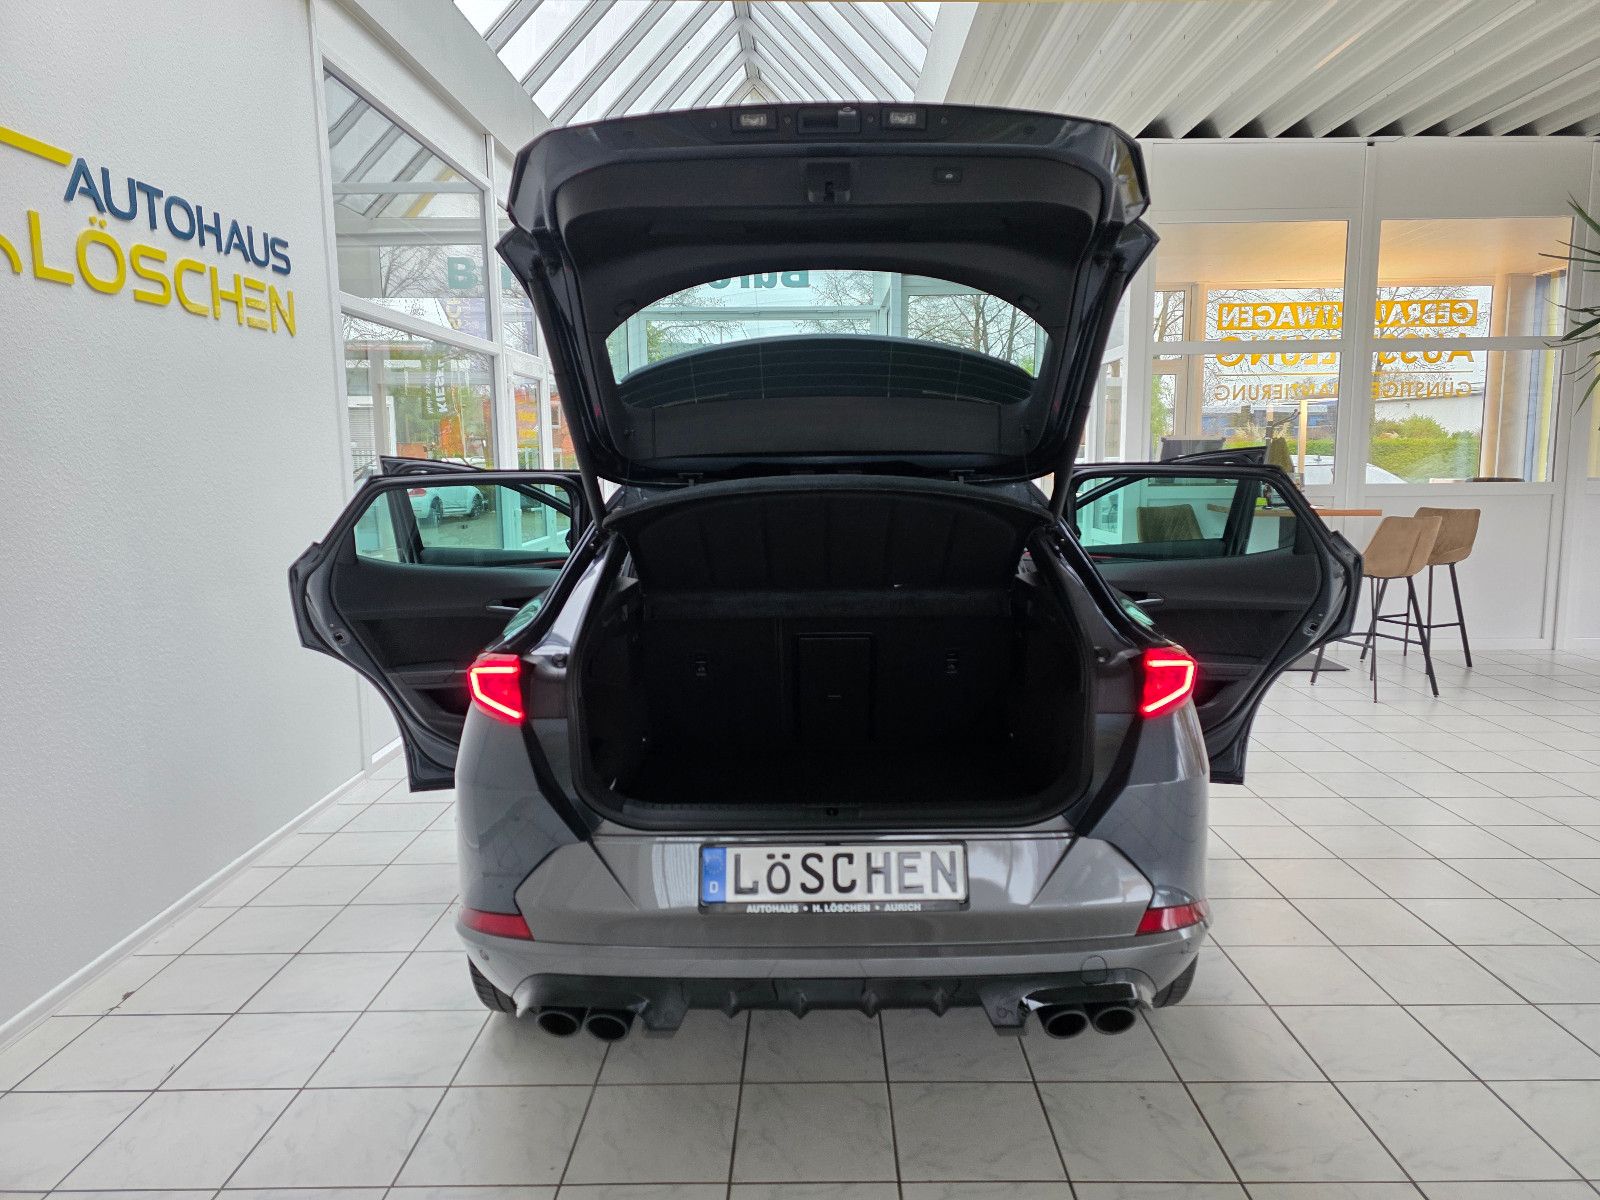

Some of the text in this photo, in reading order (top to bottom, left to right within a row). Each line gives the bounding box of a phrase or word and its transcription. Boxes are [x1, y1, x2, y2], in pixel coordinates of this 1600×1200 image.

[64, 157, 292, 275] AUTOHAUS
[27, 209, 297, 337] LÖSCHEN
[709, 881, 719, 894] D
[734, 851, 958, 895] LÖSCHEN
[746, 903, 799, 913] AUTOHAUS
[824, 902, 871, 913] LÖSCHEN
[884, 903, 922, 912] AURICH
